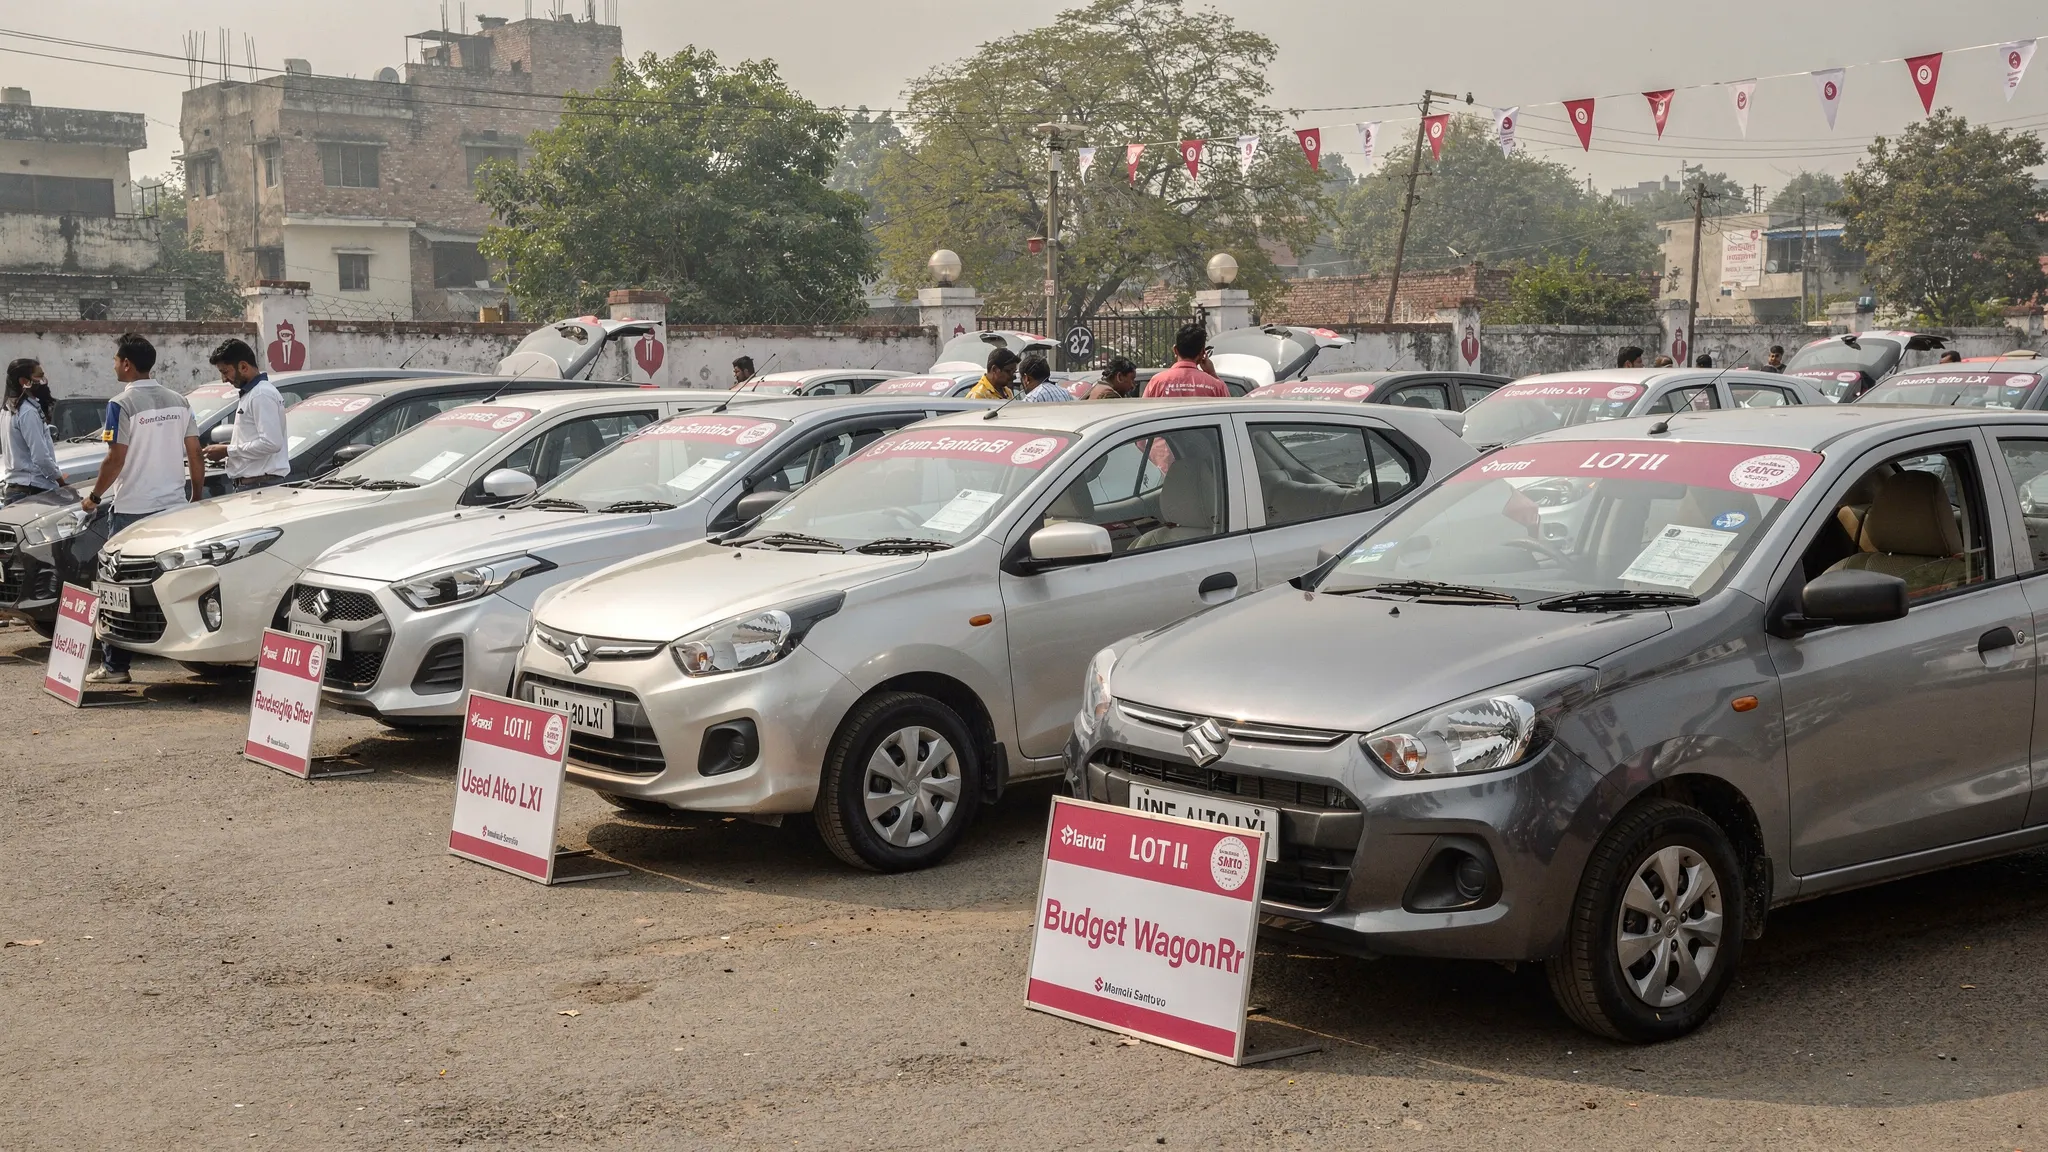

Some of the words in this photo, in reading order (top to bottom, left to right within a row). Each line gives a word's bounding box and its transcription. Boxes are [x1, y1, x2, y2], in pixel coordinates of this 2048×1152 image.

[1538, 386, 1564, 395] Alto
[1566, 387, 1591, 396] LXI
[586, 706, 603, 730] LXI
[461, 768, 492, 798] Used
[492, 776, 517, 805] Alto
[519, 783, 543, 812] LXI
[1043, 898, 1127, 949] Budget
[1134, 917, 1245, 974] WagonRr
